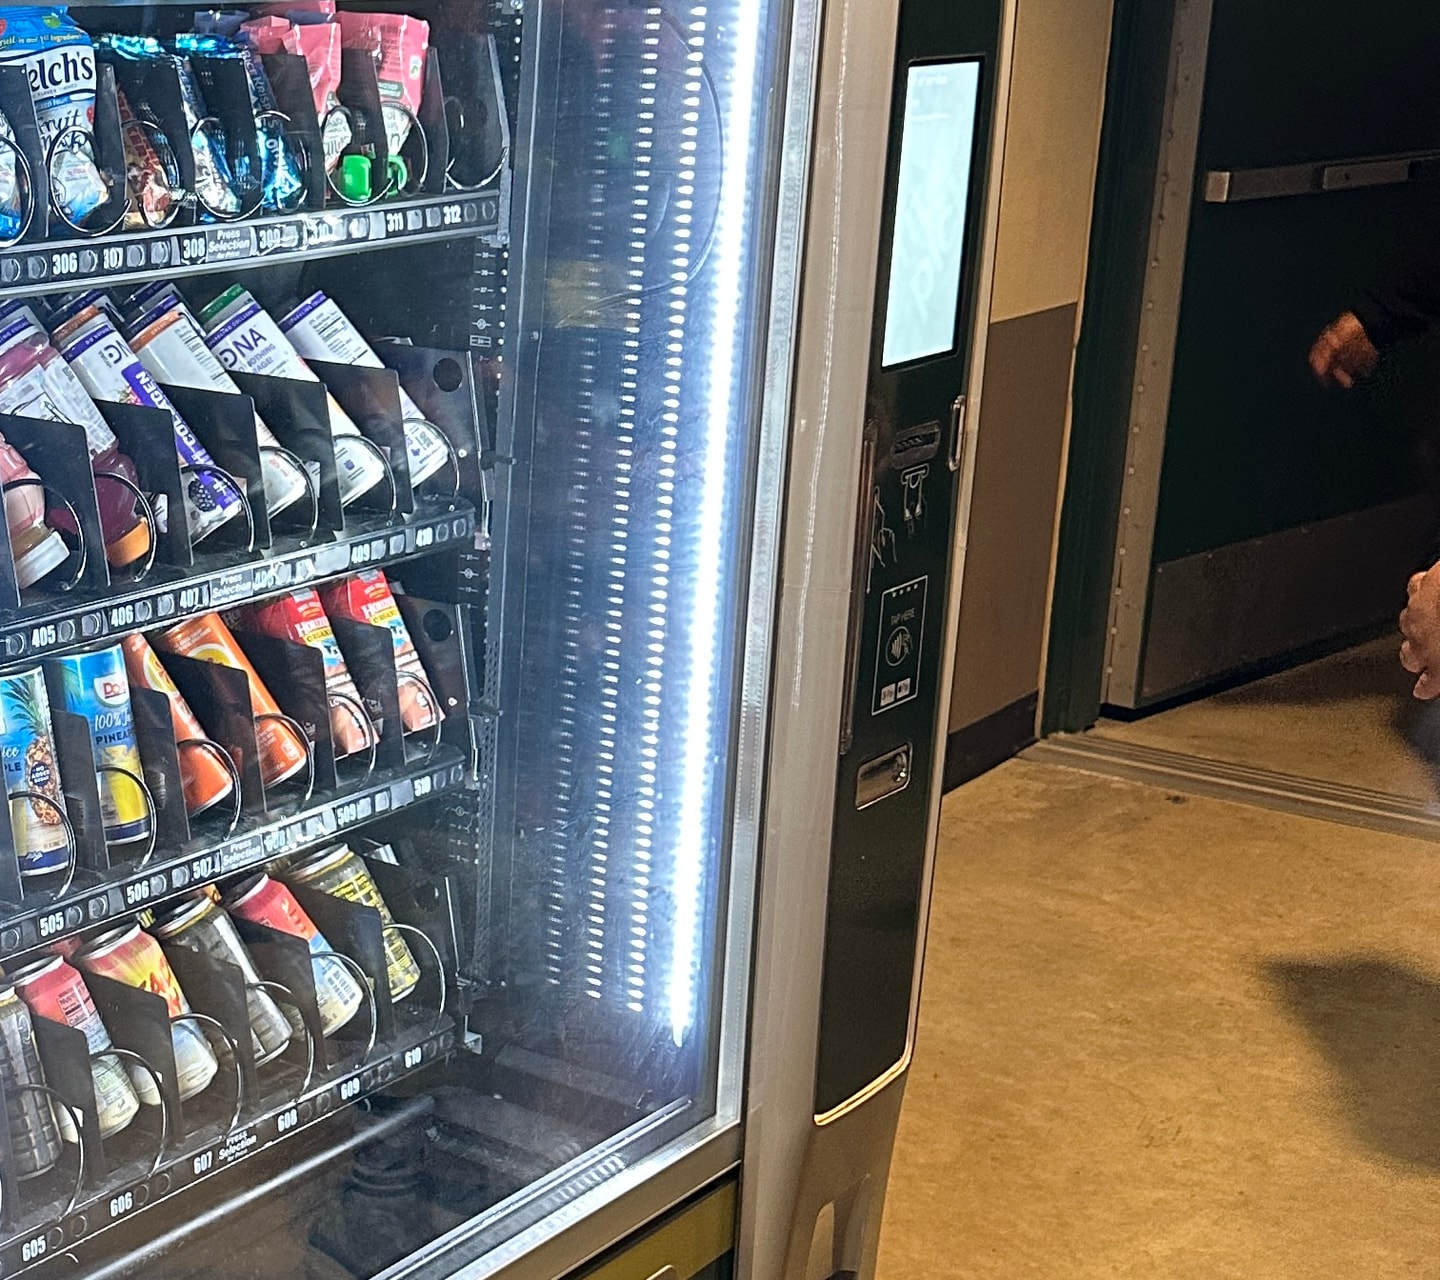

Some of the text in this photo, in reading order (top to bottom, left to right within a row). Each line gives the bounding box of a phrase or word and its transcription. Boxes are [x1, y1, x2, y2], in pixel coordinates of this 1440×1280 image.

[28, 51, 94, 93] elch's
[253, 76, 281, 130] KRISPS
[386, 210, 404, 232] 311
[443, 204, 462, 226] 312
[208, 237, 251, 255] Selection
[216, 229, 241, 242] Press
[183, 237, 206, 259] 308
[51, 252, 78, 276] 306
[414, 528, 433, 547] 410
[351, 547, 371, 565] 409
[212, 582, 253, 598] Selection
[219, 572, 243, 587] Press
[179, 589, 200, 609] 407
[111, 605, 134, 628] 406
[31, 625, 57, 647] 405
[102, 681, 127, 697] Do
[94, 710, 122, 732] 100%
[95, 727, 136, 746] PINEAP
[30, 768, 51, 780] ADDED
[414, 775, 432, 797] 510
[337, 802, 358, 824] 509
[222, 845, 262, 866] Selection
[230, 839, 253, 854] Press
[192, 857, 213, 881] 507
[126, 881, 150, 906] 506
[40, 912, 65, 938] 505
[405, 1046, 422, 1068] 610
[340, 1077, 360, 1101] 609
[277, 1108, 297, 1132] 608
[217, 1134, 257, 1161] Selection
[225, 1129, 249, 1147] Press
[193, 1150, 213, 1175] 607
[110, 1192, 133, 1218] 606
[21, 1235, 47, 1263] 605
